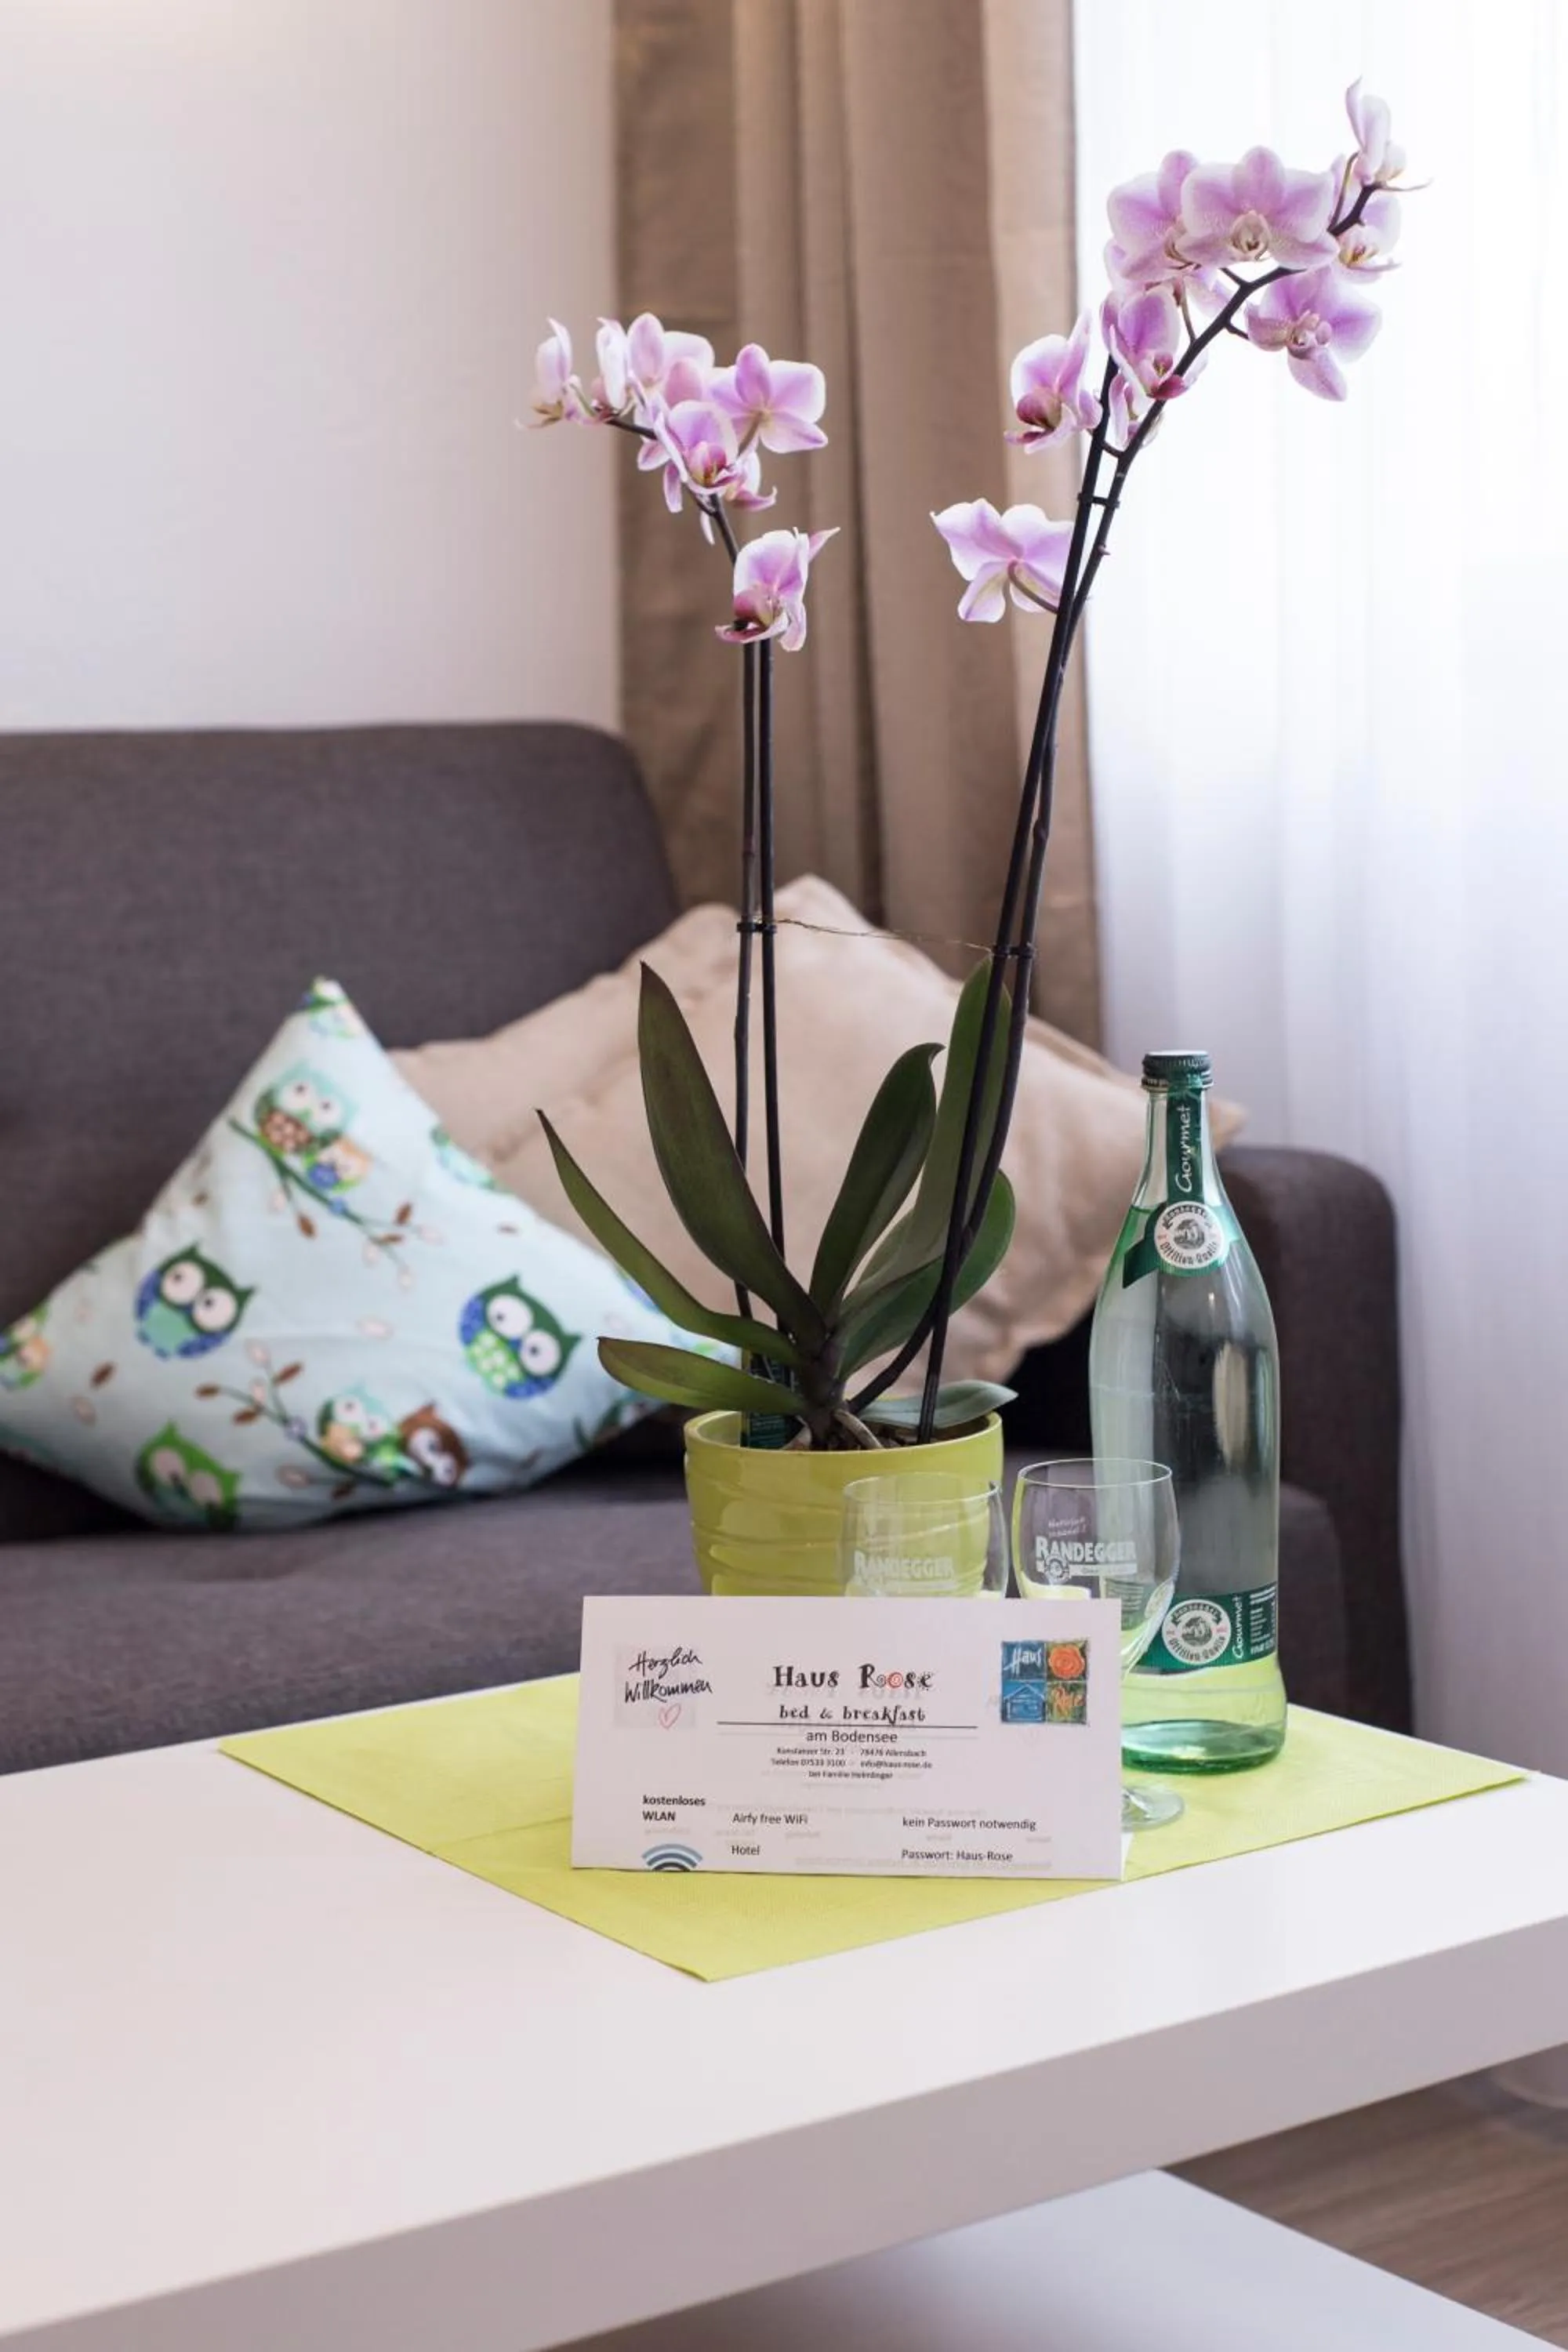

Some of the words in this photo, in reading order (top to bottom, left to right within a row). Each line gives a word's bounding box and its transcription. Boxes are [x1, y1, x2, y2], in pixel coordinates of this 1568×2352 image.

[1175, 1102, 1192, 1193] Gourmet
[1036, 1536, 1136, 1563] RANDEGGER
[1232, 1595, 1244, 1659] Gourmet
[628, 1646, 703, 1680] Herzlich
[772, 1664, 840, 1688] Haus
[858, 1663, 935, 1691] Rose
[624, 1679, 713, 1704] Willkommen
[779, 1704, 810, 1719] bed
[818, 1707, 833, 1719] &
[842, 1704, 926, 1724] breakfast
[805, 1732, 827, 1741] am
[831, 1730, 898, 1743] Bodensee
[642, 1795, 706, 1806] kostenloses
[642, 1810, 676, 1821] WLAN
[732, 1812, 757, 1825] Airfy
[760, 1813, 782, 1824] free
[784, 1813, 808, 1824] WiFi
[902, 1817, 925, 1828] kein
[927, 1817, 976, 1828] Passwort
[979, 1819, 1036, 1831] notwendig
[731, 1844, 760, 1856] Hotel
[902, 1849, 954, 1860] Passwort:
[956, 1849, 1013, 1861] Haus-Rose
